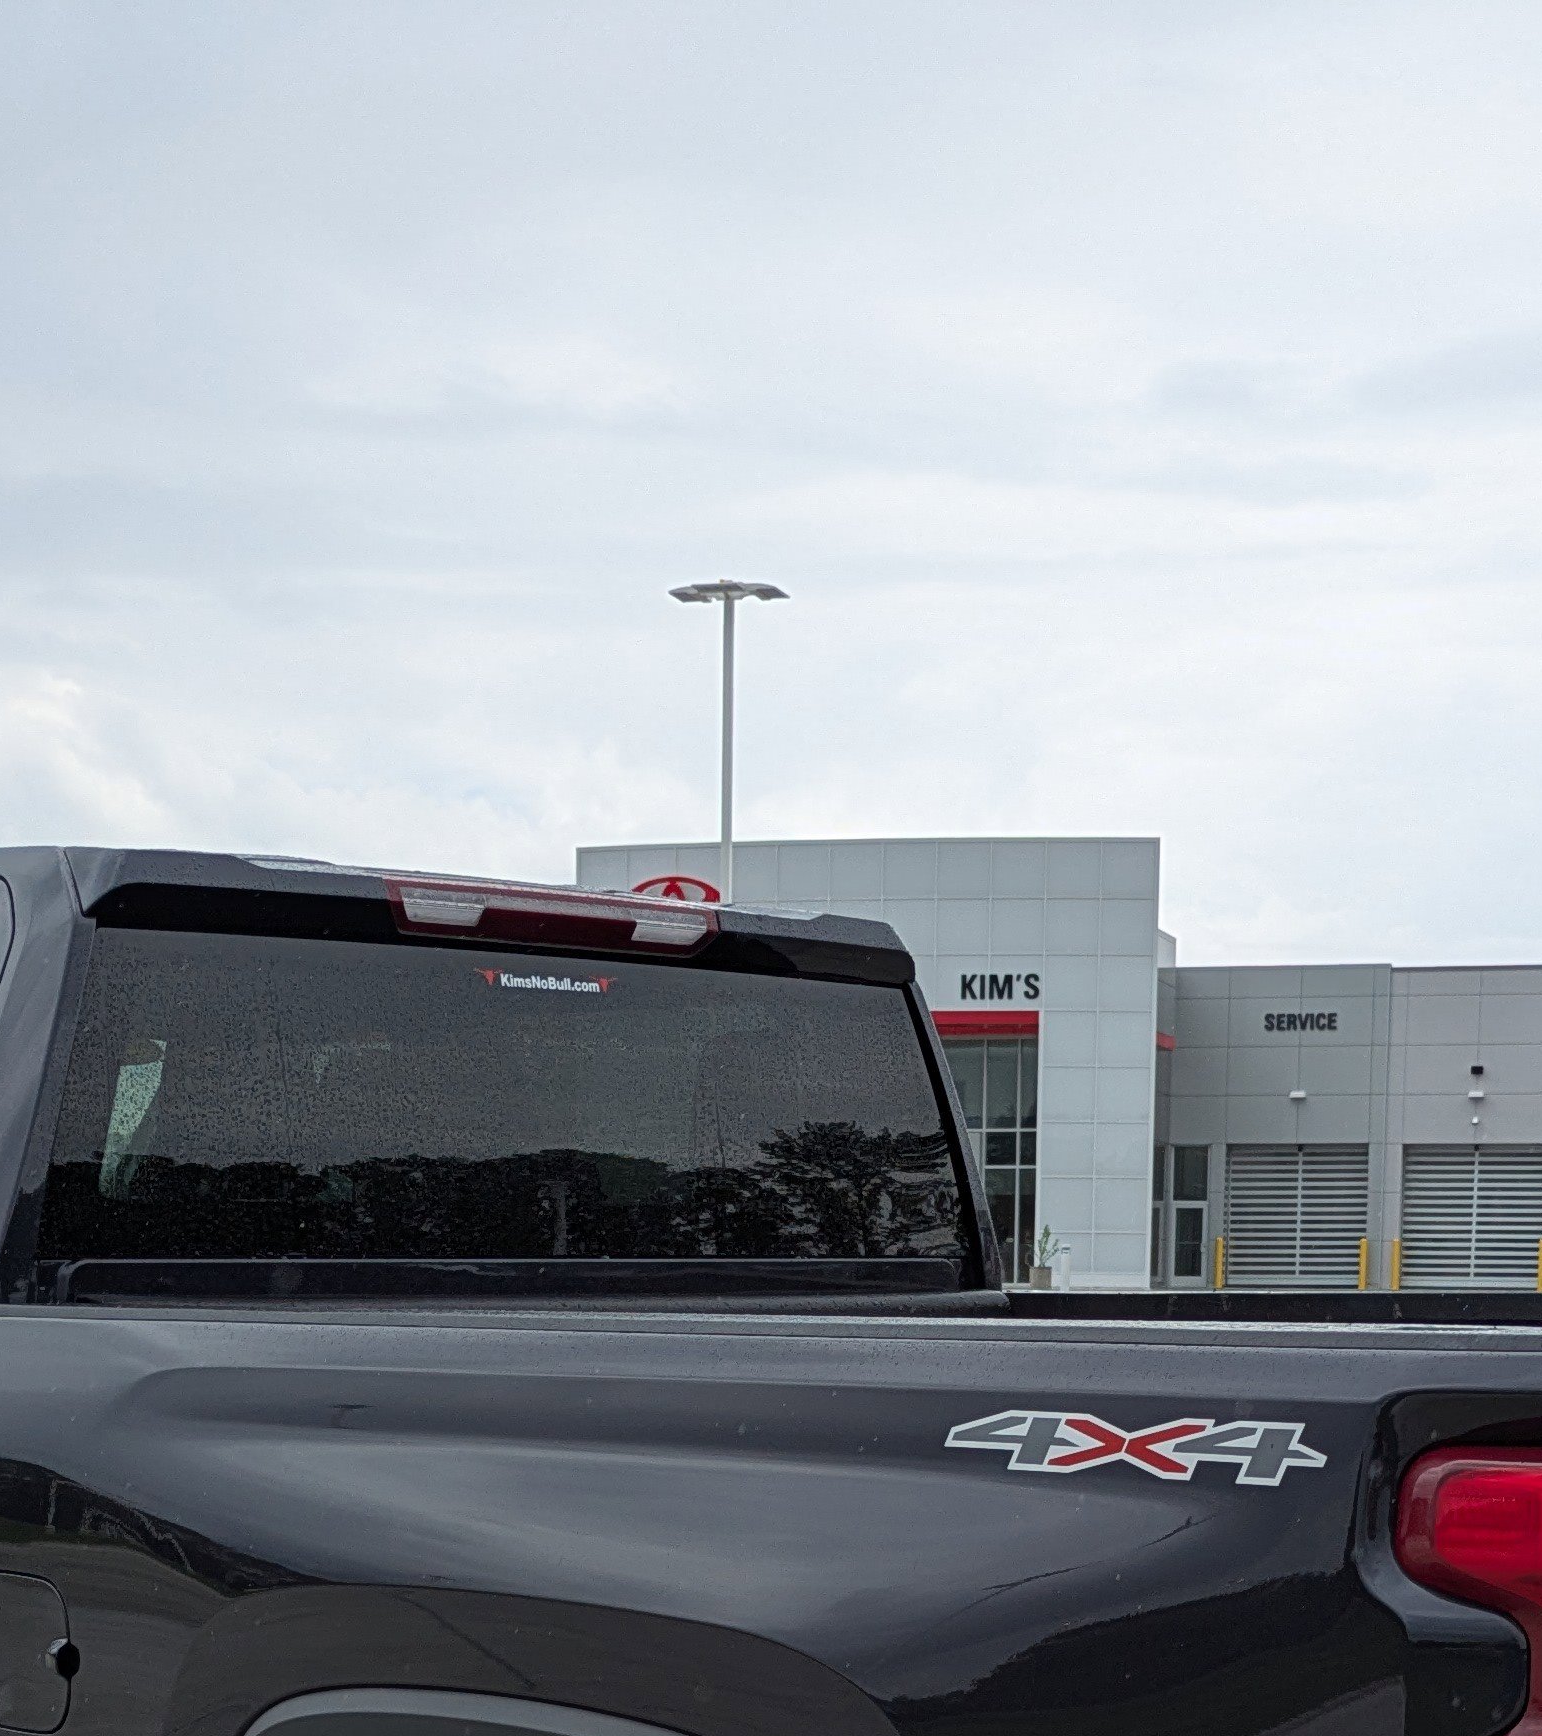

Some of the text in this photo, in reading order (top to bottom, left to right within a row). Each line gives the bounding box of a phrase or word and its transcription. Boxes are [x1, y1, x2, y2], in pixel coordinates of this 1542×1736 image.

[500, 972, 601, 993] KimsNoBull.com
[960, 973, 1040, 1000] KIM'S
[1264, 1012, 1338, 1032] SERVICE
